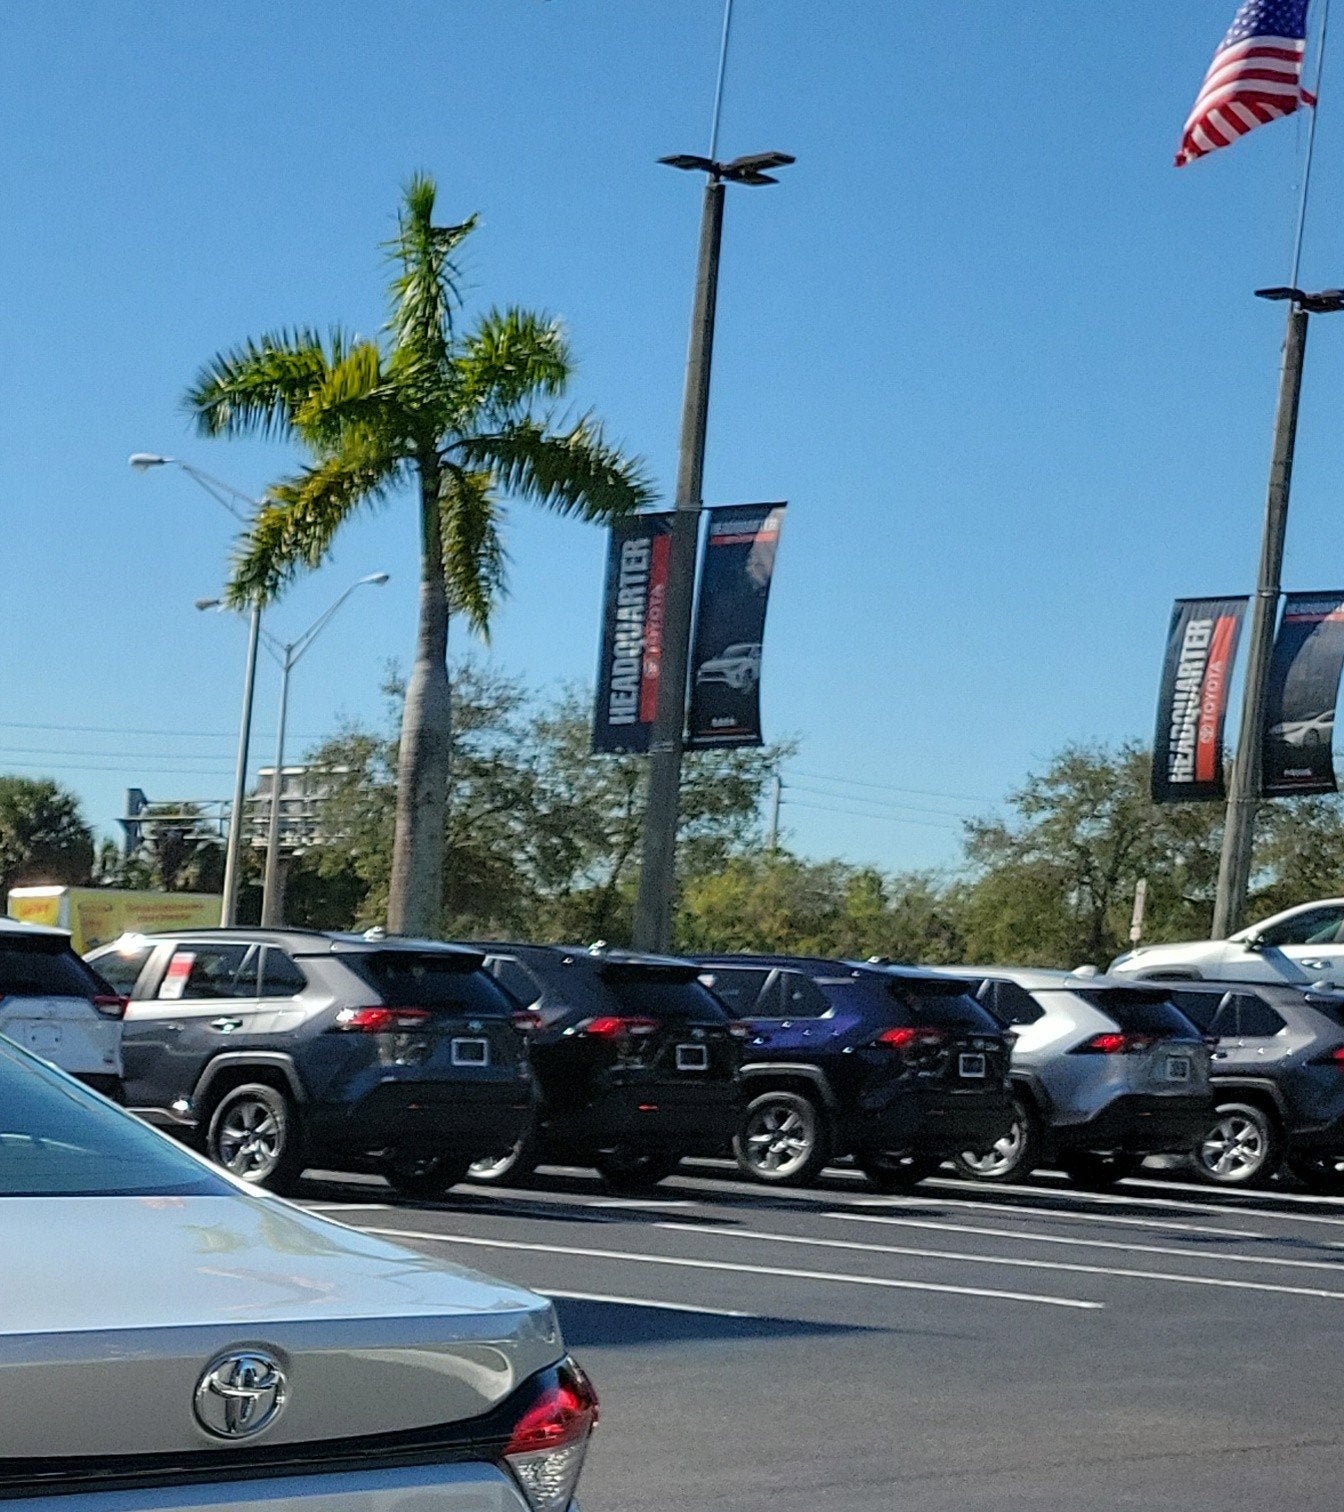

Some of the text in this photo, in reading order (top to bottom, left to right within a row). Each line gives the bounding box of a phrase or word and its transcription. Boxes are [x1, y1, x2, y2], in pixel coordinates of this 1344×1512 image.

[608, 537, 652, 727] HEADQUARTER
[1168, 618, 1215, 783] HEADQUARTER
[1201, 660, 1224, 722] TOYOTA
